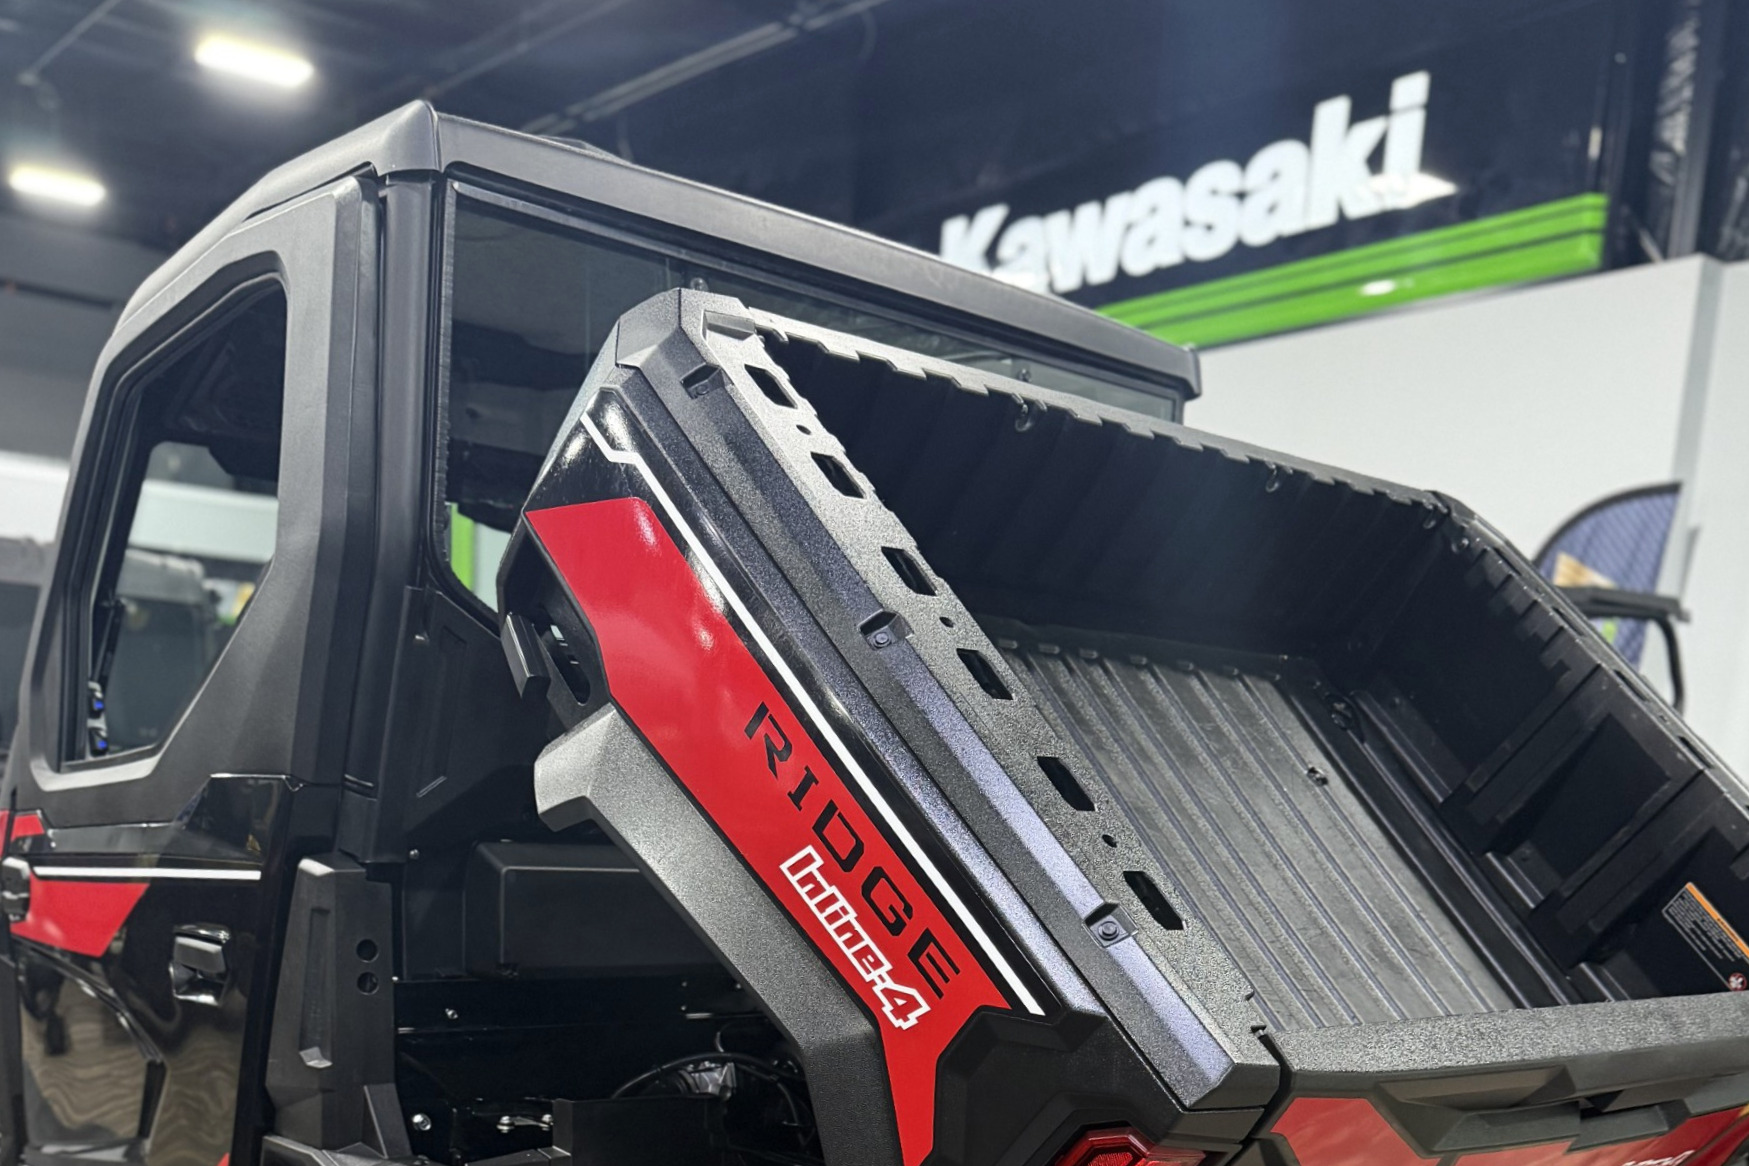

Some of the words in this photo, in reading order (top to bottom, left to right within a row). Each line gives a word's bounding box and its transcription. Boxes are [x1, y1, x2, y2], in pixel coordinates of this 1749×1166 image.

[940, 70, 1430, 295] Kawasaki
[744, 701, 961, 999] RIDGE
[779, 844, 931, 1030] Inline-4
